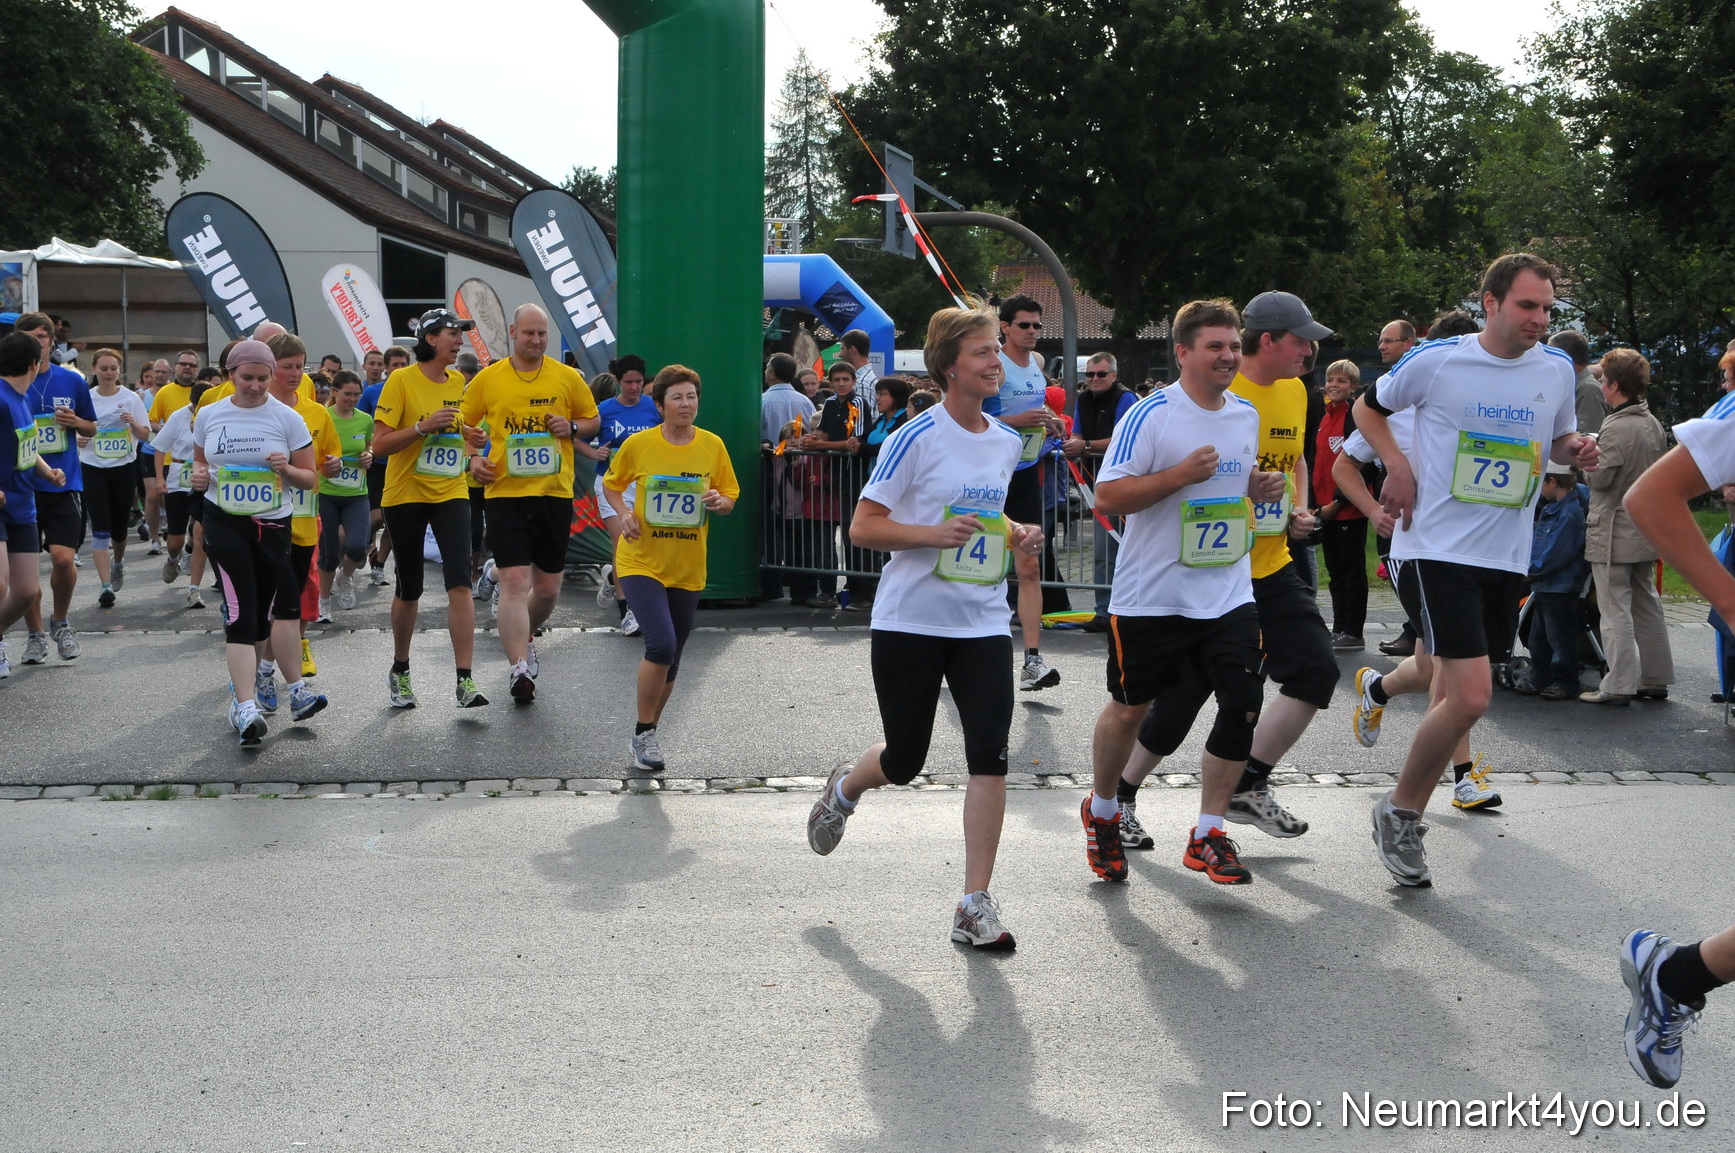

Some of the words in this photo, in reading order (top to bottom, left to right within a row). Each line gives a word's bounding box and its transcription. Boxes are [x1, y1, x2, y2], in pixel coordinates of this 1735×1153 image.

[1478, 402, 1534, 422] heinloth
[1270, 428, 1291, 436] swn
[96, 440, 127, 450] 1202
[425, 446, 458, 466] 189
[513, 448, 550, 466] 186
[1474, 458, 1510, 488] 73
[221, 484, 272, 502] 1006
[290, 487, 304, 506] 1
[962, 484, 1005, 502] heinloth
[1463, 484, 1494, 494] Christian
[652, 492, 696, 514] 178
[652, 530, 674, 538] Alles
[676, 531, 698, 540] läuft
[1196, 522, 1228, 550] 72
[1192, 550, 1216, 558] Edmund
